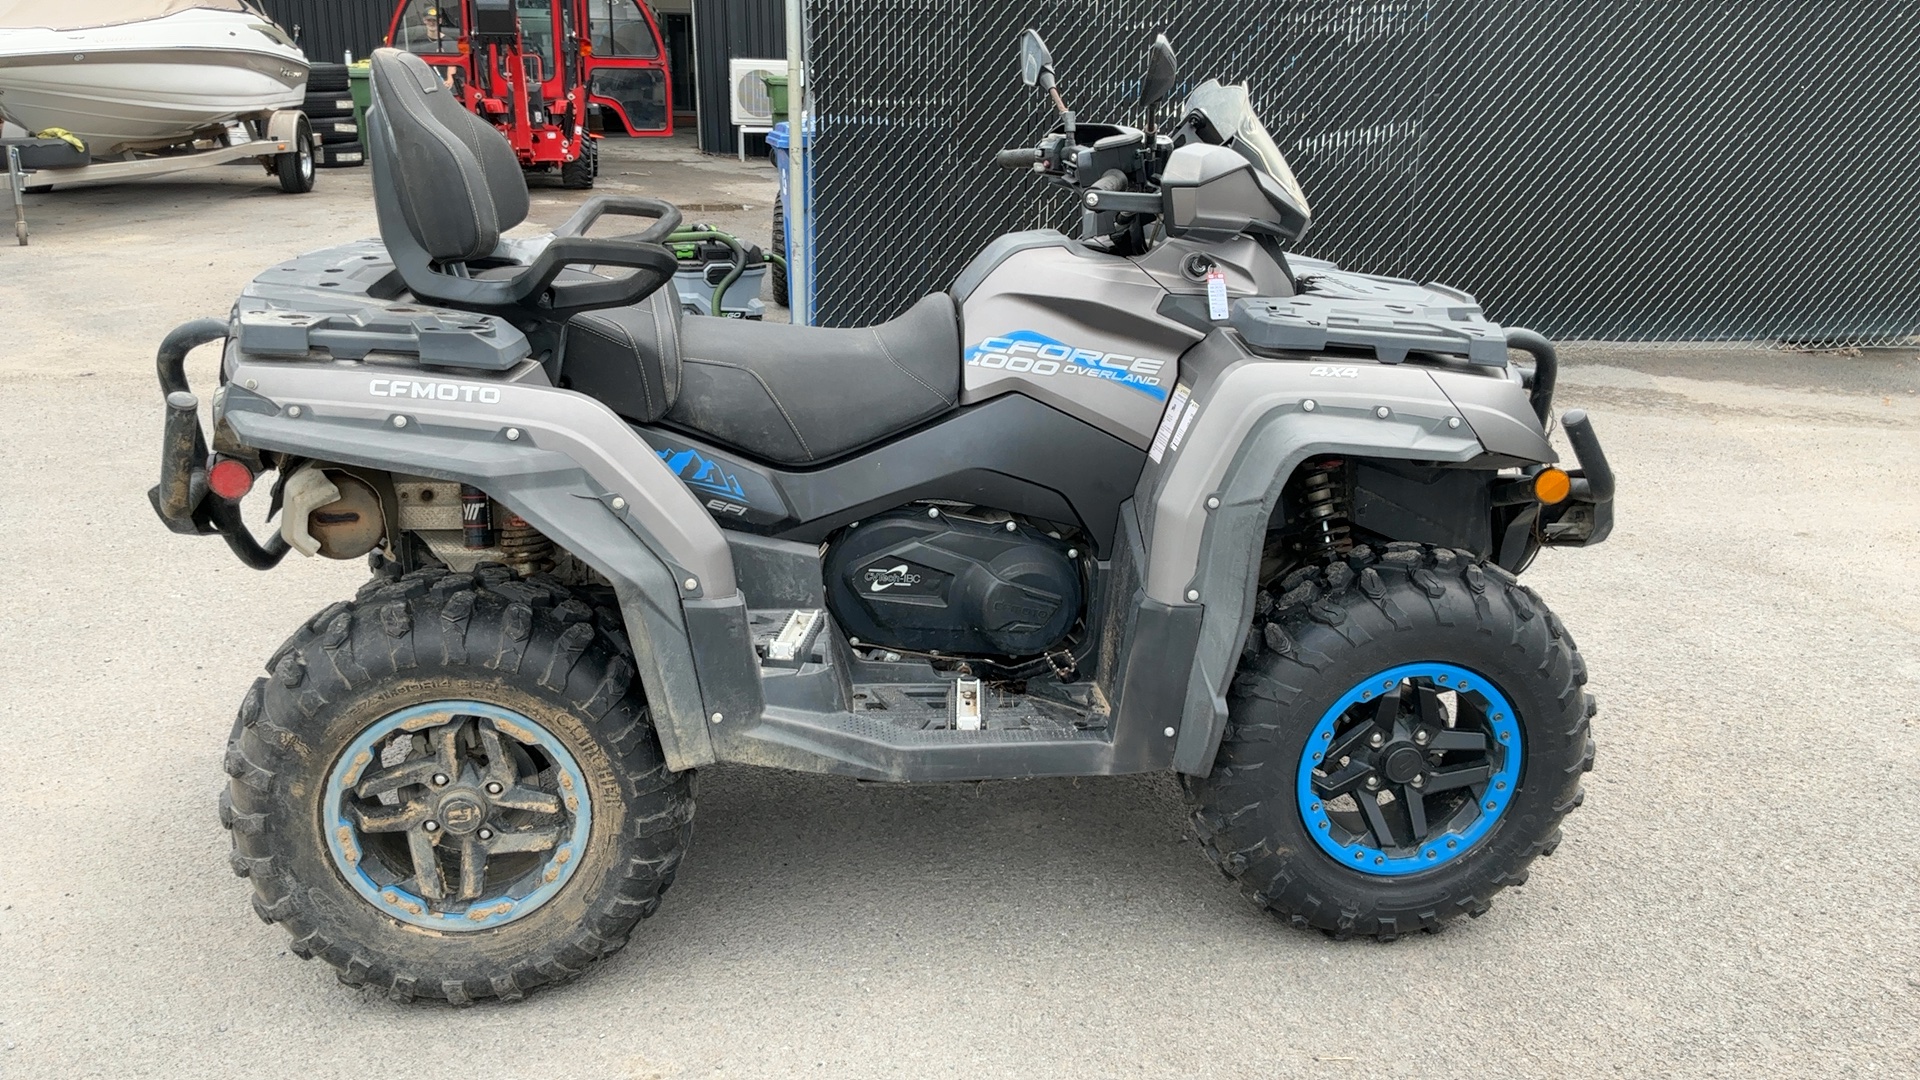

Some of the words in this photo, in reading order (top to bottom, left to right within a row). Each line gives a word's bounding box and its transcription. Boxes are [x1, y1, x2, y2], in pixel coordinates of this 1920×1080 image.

[968, 352, 1060, 376] 1000
[1063, 365, 1161, 387] OVERLAND
[978, 336, 1166, 375] CFORCE
[369, 378, 501, 404] CFMOTO
[706, 499, 748, 516] EFI
